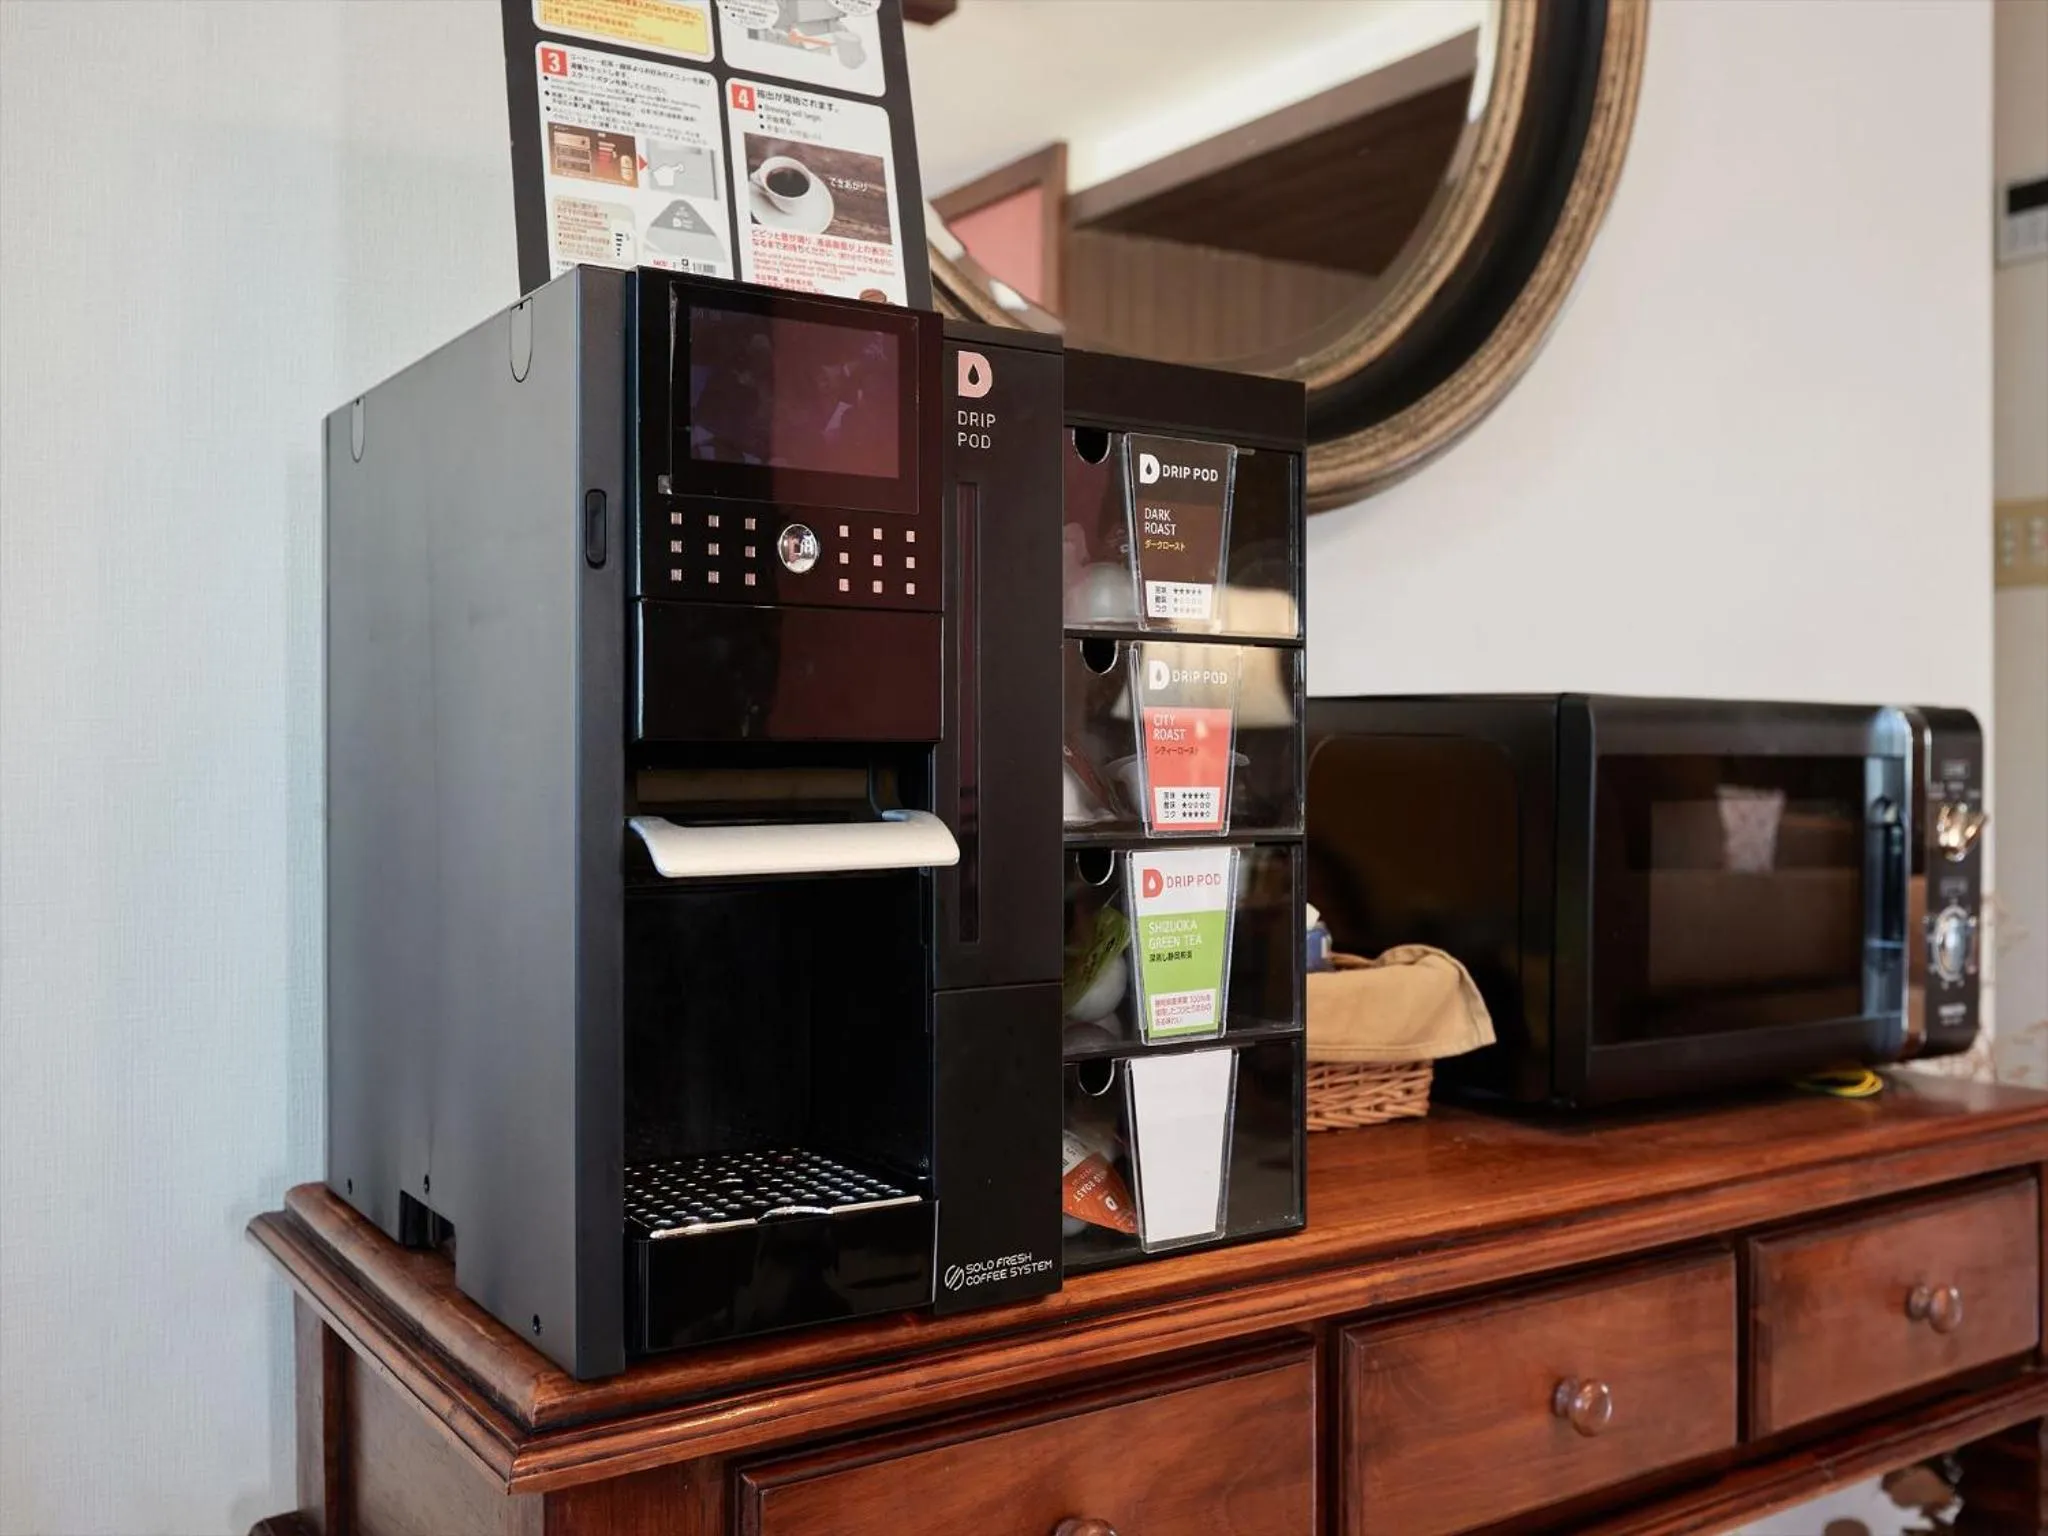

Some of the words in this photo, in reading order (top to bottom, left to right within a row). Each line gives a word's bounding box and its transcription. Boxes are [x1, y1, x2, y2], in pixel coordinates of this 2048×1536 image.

[547, 52, 561, 72] 3
[738, 89, 750, 108] 4
[957, 410, 996, 429] DRIP
[957, 432, 991, 449] POD
[1162, 464, 1191, 479] DRIP
[1193, 468, 1219, 482] POD
[1144, 507, 1171, 522] DARK
[1144, 522, 1177, 536] ROAST
[1144, 539, 1186, 552] ダークロースト
[1172, 670, 1200, 684] DRIP
[1203, 671, 1228, 685] POD
[1153, 714, 1176, 727] CITY
[1153, 728, 1187, 741] ROAST
[1166, 874, 1194, 889] DRIP
[1196, 873, 1222, 886] POD
[1149, 919, 1198, 935] SHIZUOKA
[1149, 935, 1181, 950] GREEN
[1184, 934, 1202, 947] TEA
[965, 1260, 995, 1275] SOLO
[996, 1252, 1032, 1269] FRESH
[965, 1269, 1008, 1286] COFFEE
[1010, 1260, 1053, 1277] SYSTEM
